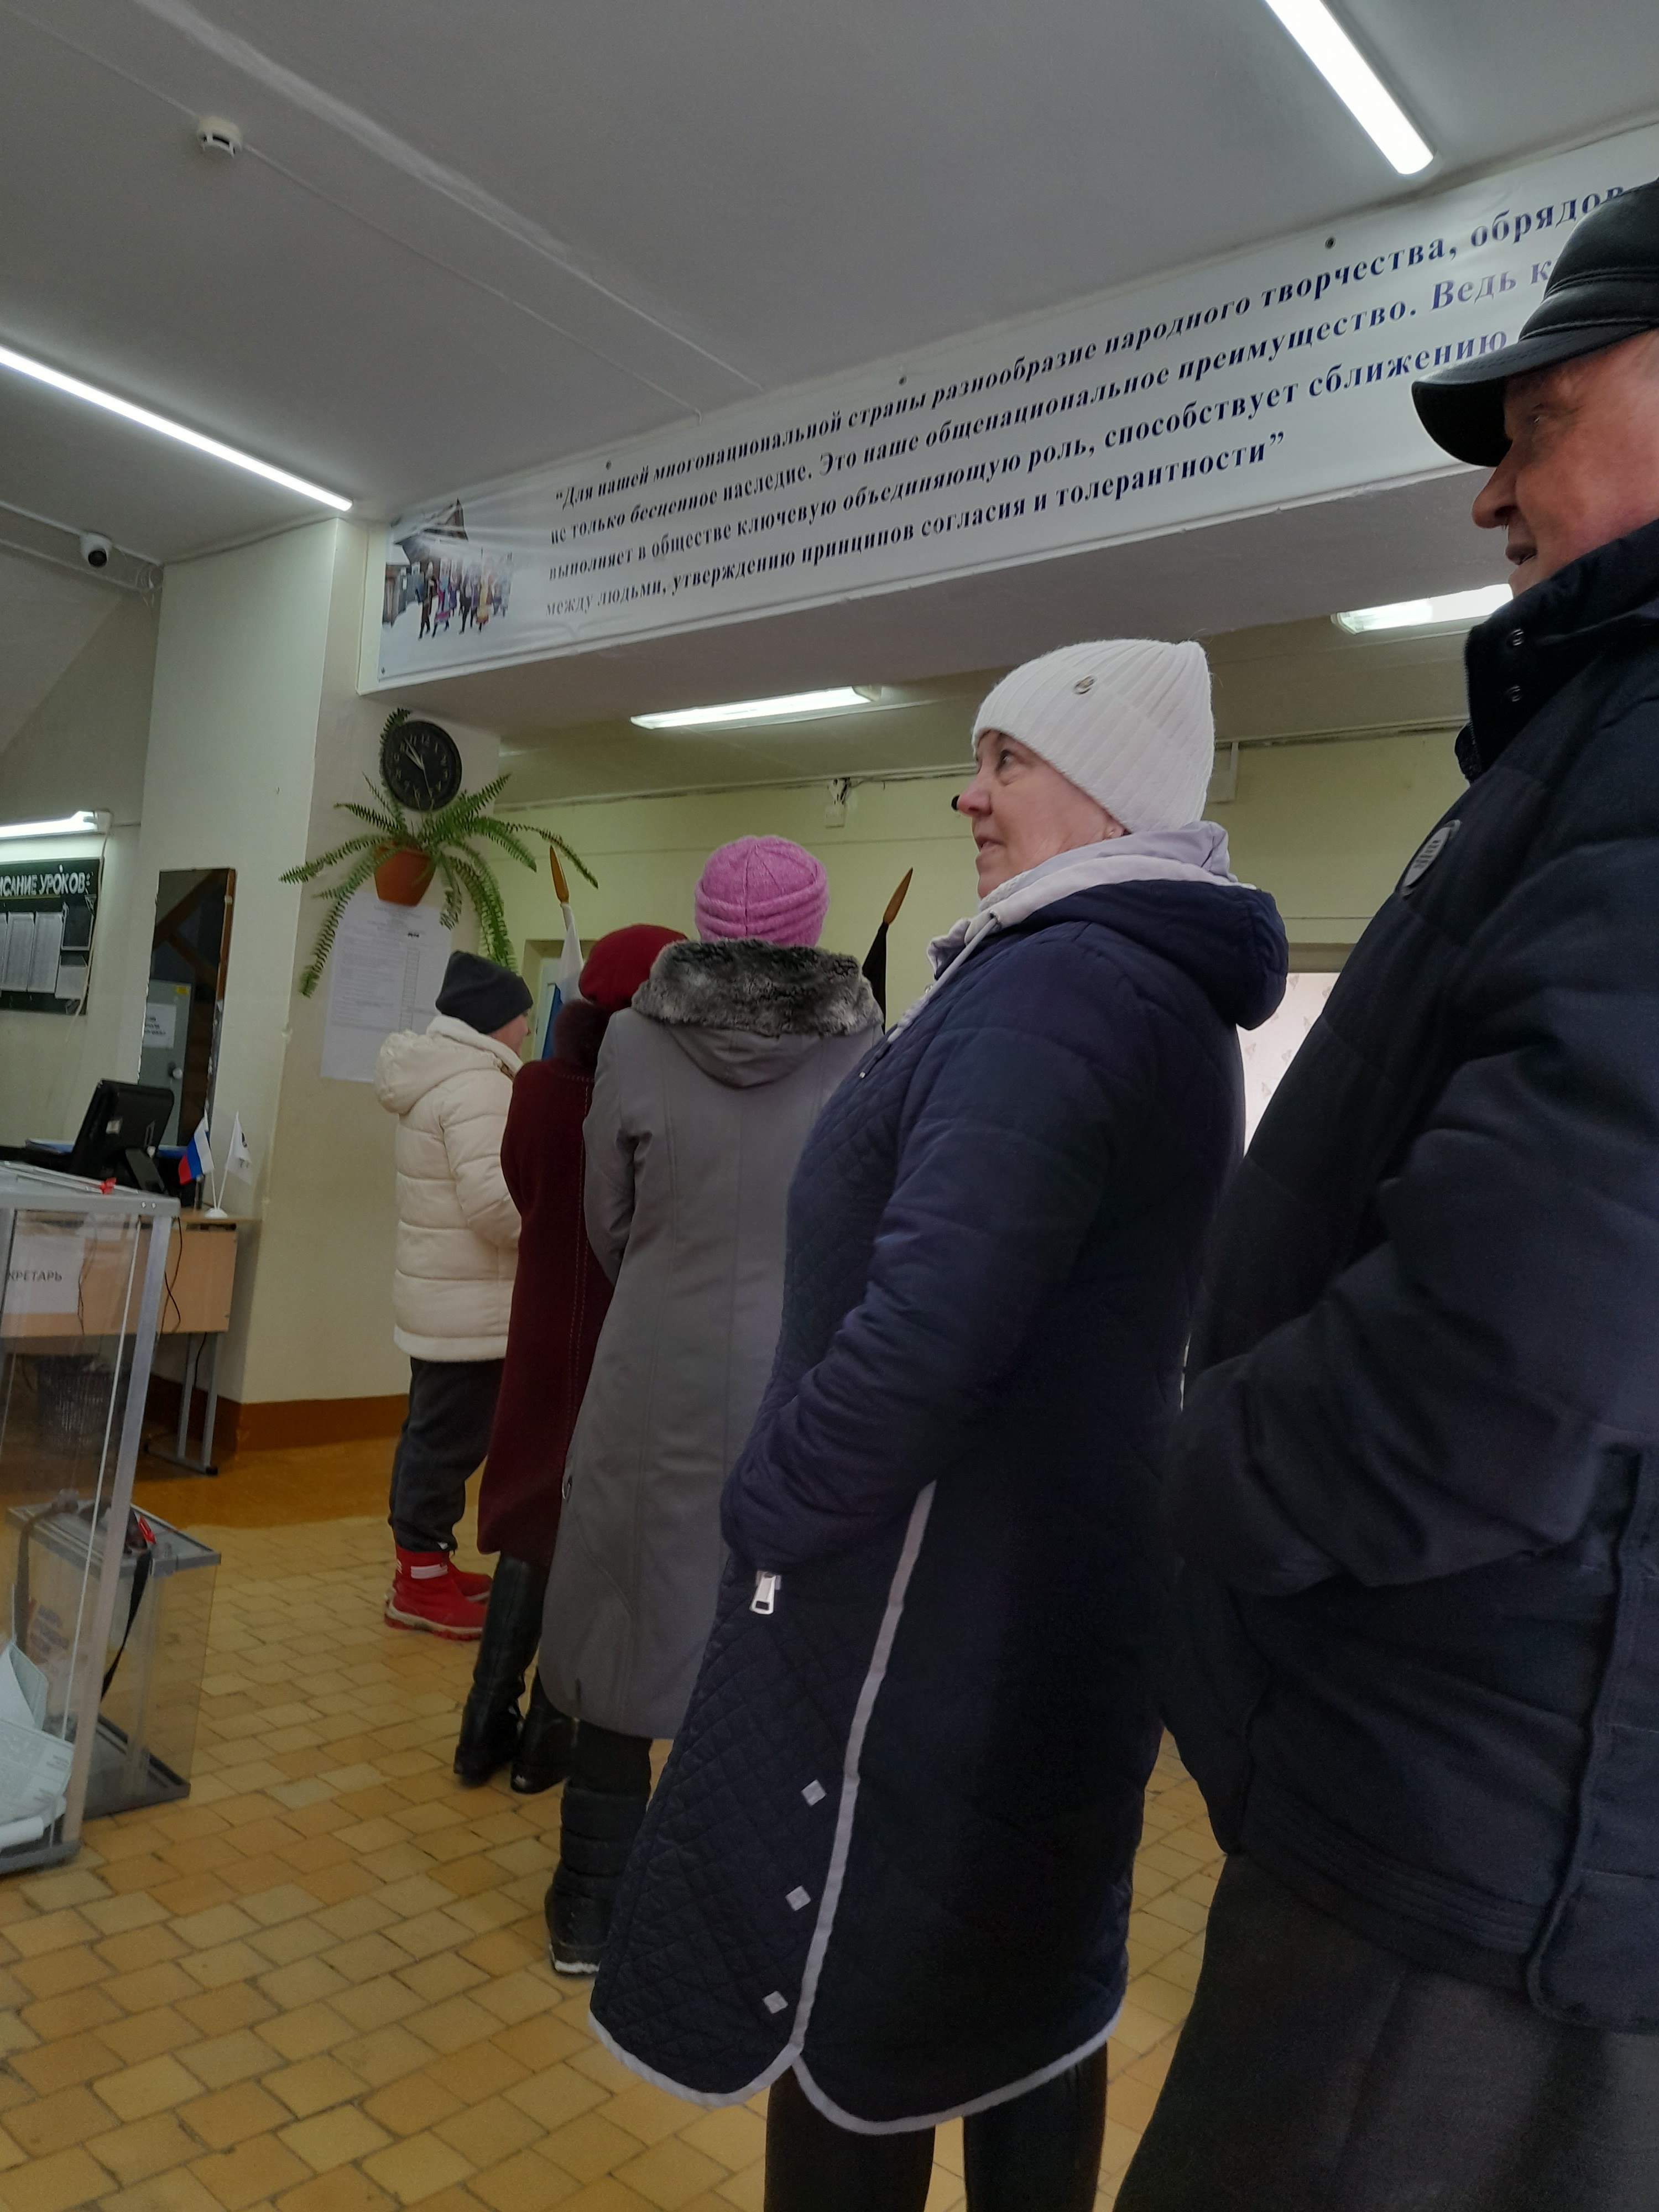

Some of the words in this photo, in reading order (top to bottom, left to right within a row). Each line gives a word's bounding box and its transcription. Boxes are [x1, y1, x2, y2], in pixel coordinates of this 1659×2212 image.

[549, 547, 633, 581] выполняет
[638, 544, 648, 563] в
[651, 524, 731, 559] обществе
[737, 498, 837, 537] ключевую
[843, 454, 1021, 512] объединяющую
[1027, 438, 1095, 474] роль,
[1104, 383, 1299, 448] способствует
[1308, 331, 1507, 397] сближению
[550, 526, 567, 546] не
[571, 512, 626, 540] только
[630, 490, 718, 524] бесценное
[723, 465, 812, 502] наследие.
[820, 451, 857, 476] Это
[863, 435, 919, 465] наше
[926, 367, 1169, 447] общенациональное
[1178, 301, 1416, 383] преимущество.
[1431, 271, 1516, 311] Ведь
[597, 464, 650, 498] нашей
[653, 409, 842, 483] многонациональной
[848, 392, 927, 429] страны
[931, 342, 1097, 410] разнообразие
[1104, 296, 1250, 356] народного
[1261, 238, 1458, 309] творчества,
[546, 593, 593, 616] между
[597, 580, 666, 607] людьми,
[671, 550, 795, 597] утверждению
[802, 524, 914, 567] принципов
[921, 498, 1025, 538] согласия
[1034, 492, 1047, 513] и
